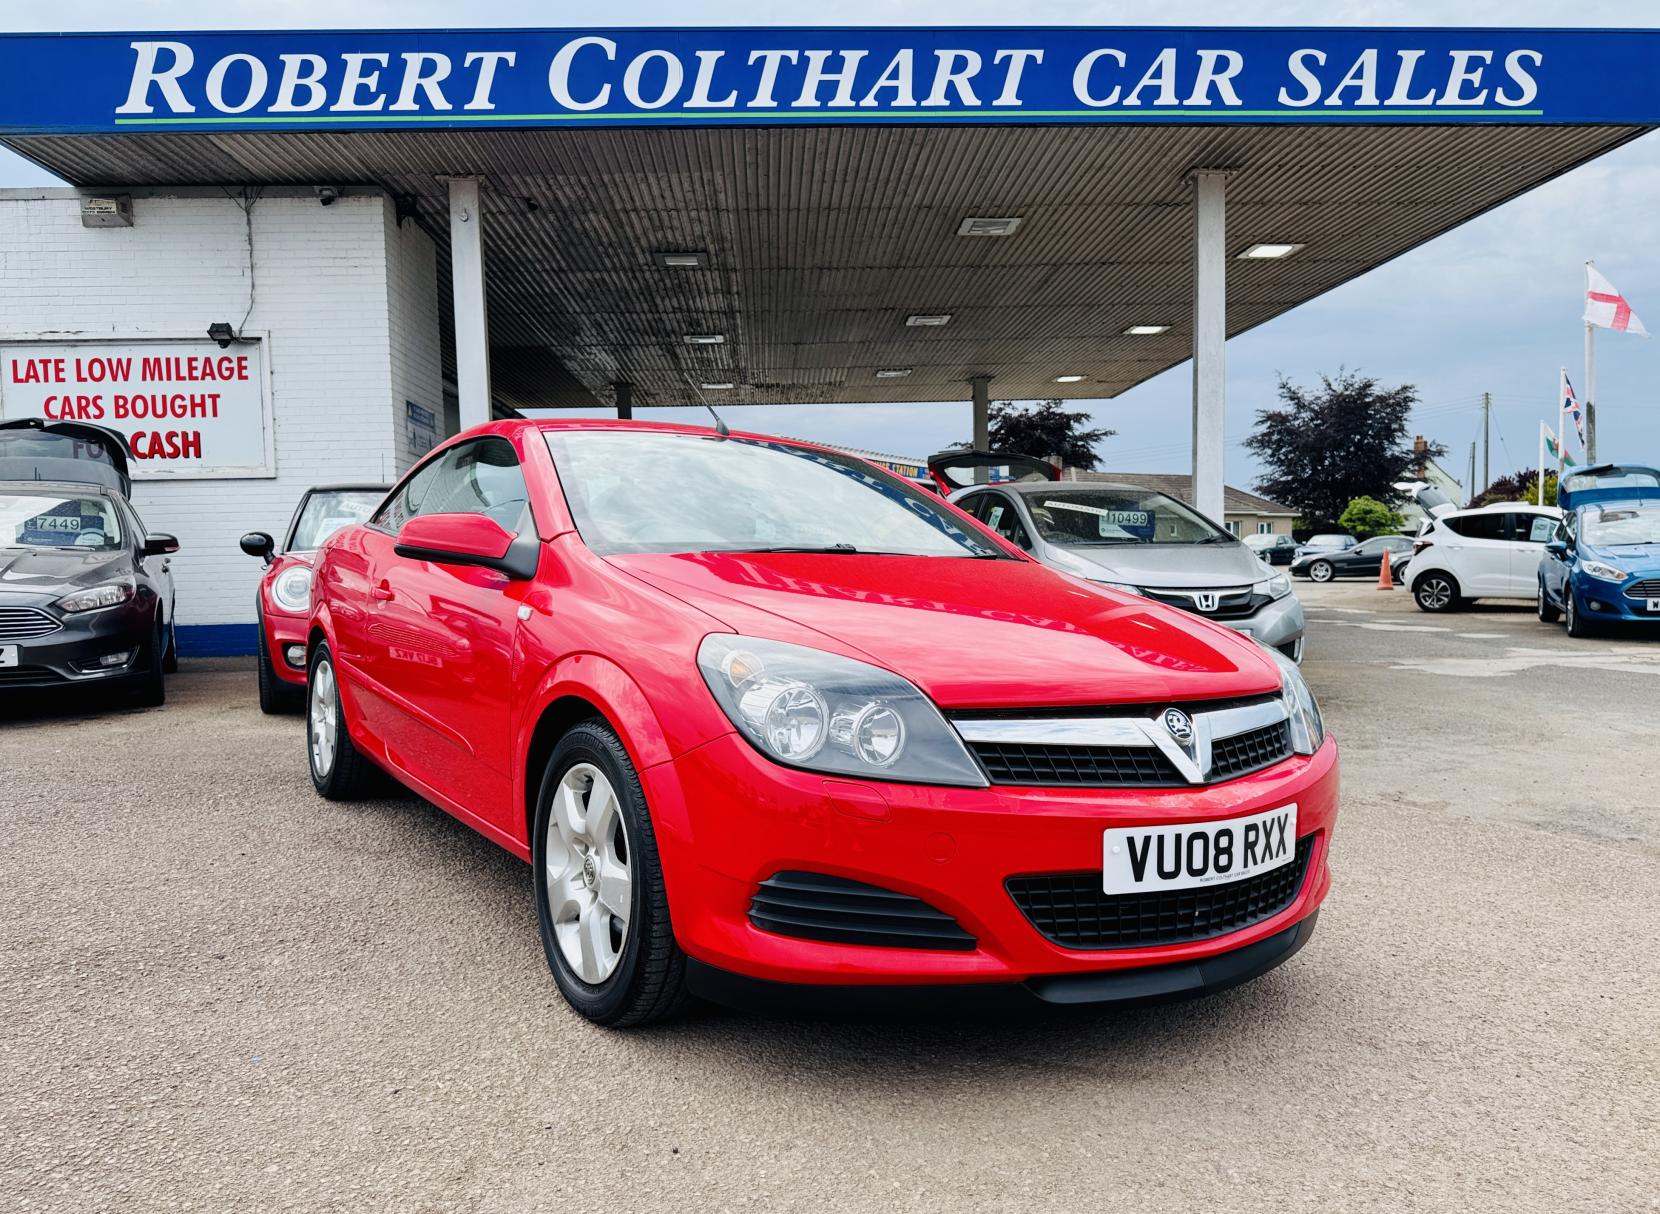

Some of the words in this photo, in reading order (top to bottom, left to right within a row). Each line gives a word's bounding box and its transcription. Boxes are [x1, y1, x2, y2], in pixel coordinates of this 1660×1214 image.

[115, 41, 517, 114] ROBERT
[548, 36, 1044, 110] COLTHART
[1072, 48, 1244, 107] CAR
[1277, 48, 1543, 107] SALES
[12, 358, 66, 384] LATE
[75, 357, 132, 383] LOW
[141, 356, 249, 382] MILEAGE
[43, 395, 105, 420] CARS
[113, 394, 220, 420] BOUGHT
[129, 430, 201, 459] CASH
[1126, 828, 1234, 882] VU08
[1243, 813, 1289, 868] RXX
